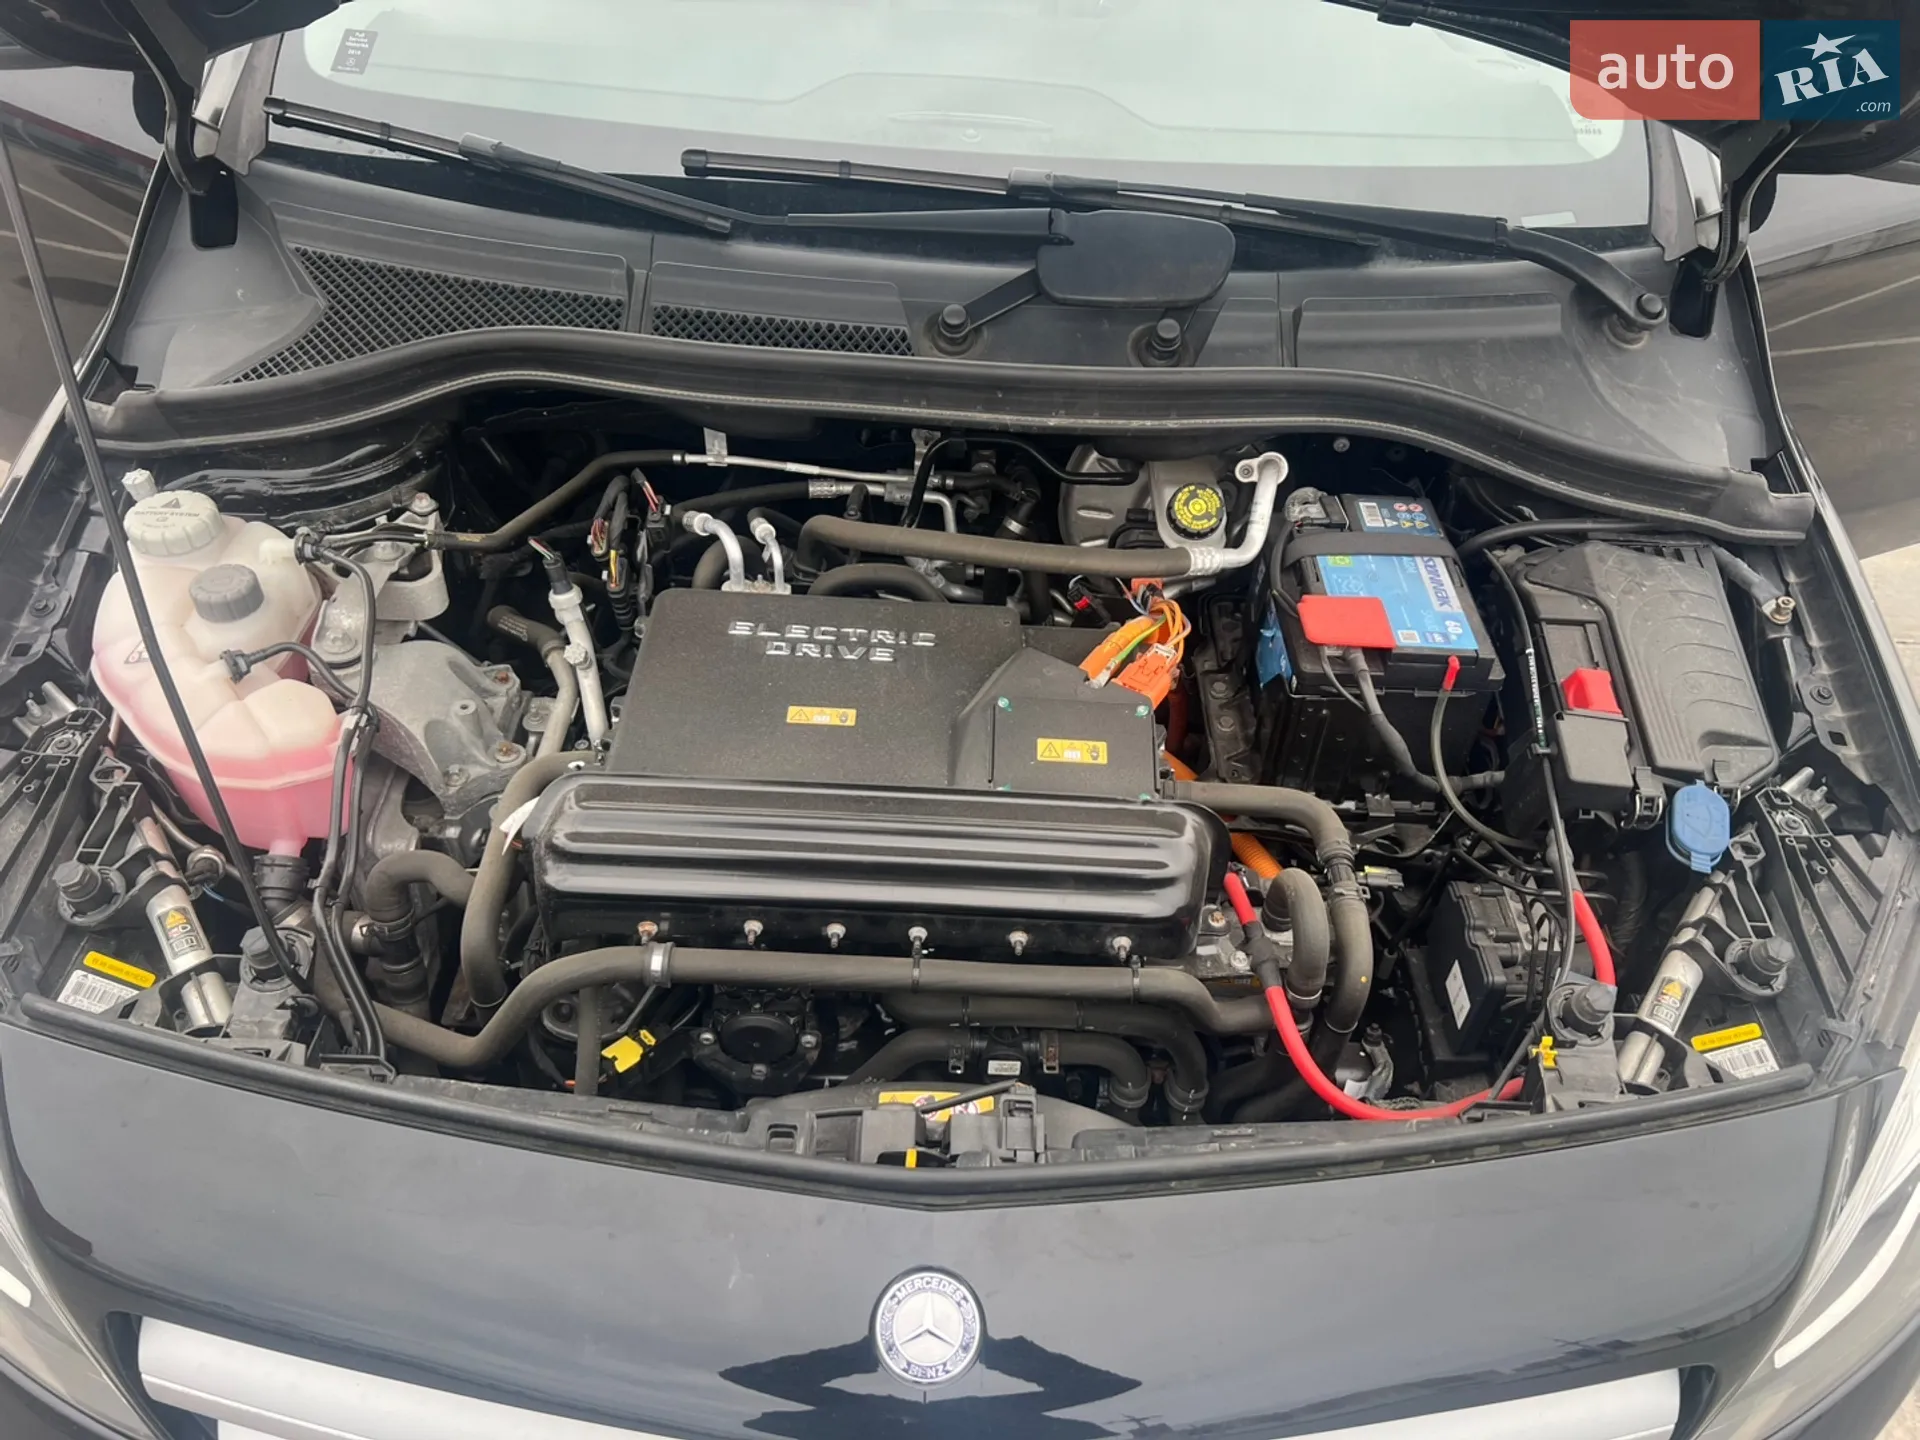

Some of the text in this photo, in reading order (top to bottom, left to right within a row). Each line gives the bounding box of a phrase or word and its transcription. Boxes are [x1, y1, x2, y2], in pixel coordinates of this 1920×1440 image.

[728, 621, 936, 647] ELECTRIC
[765, 641, 895, 662] DRIVE
[895, 1277, 963, 1300] MERCEDES
[908, 1363, 947, 1378] BENZ
